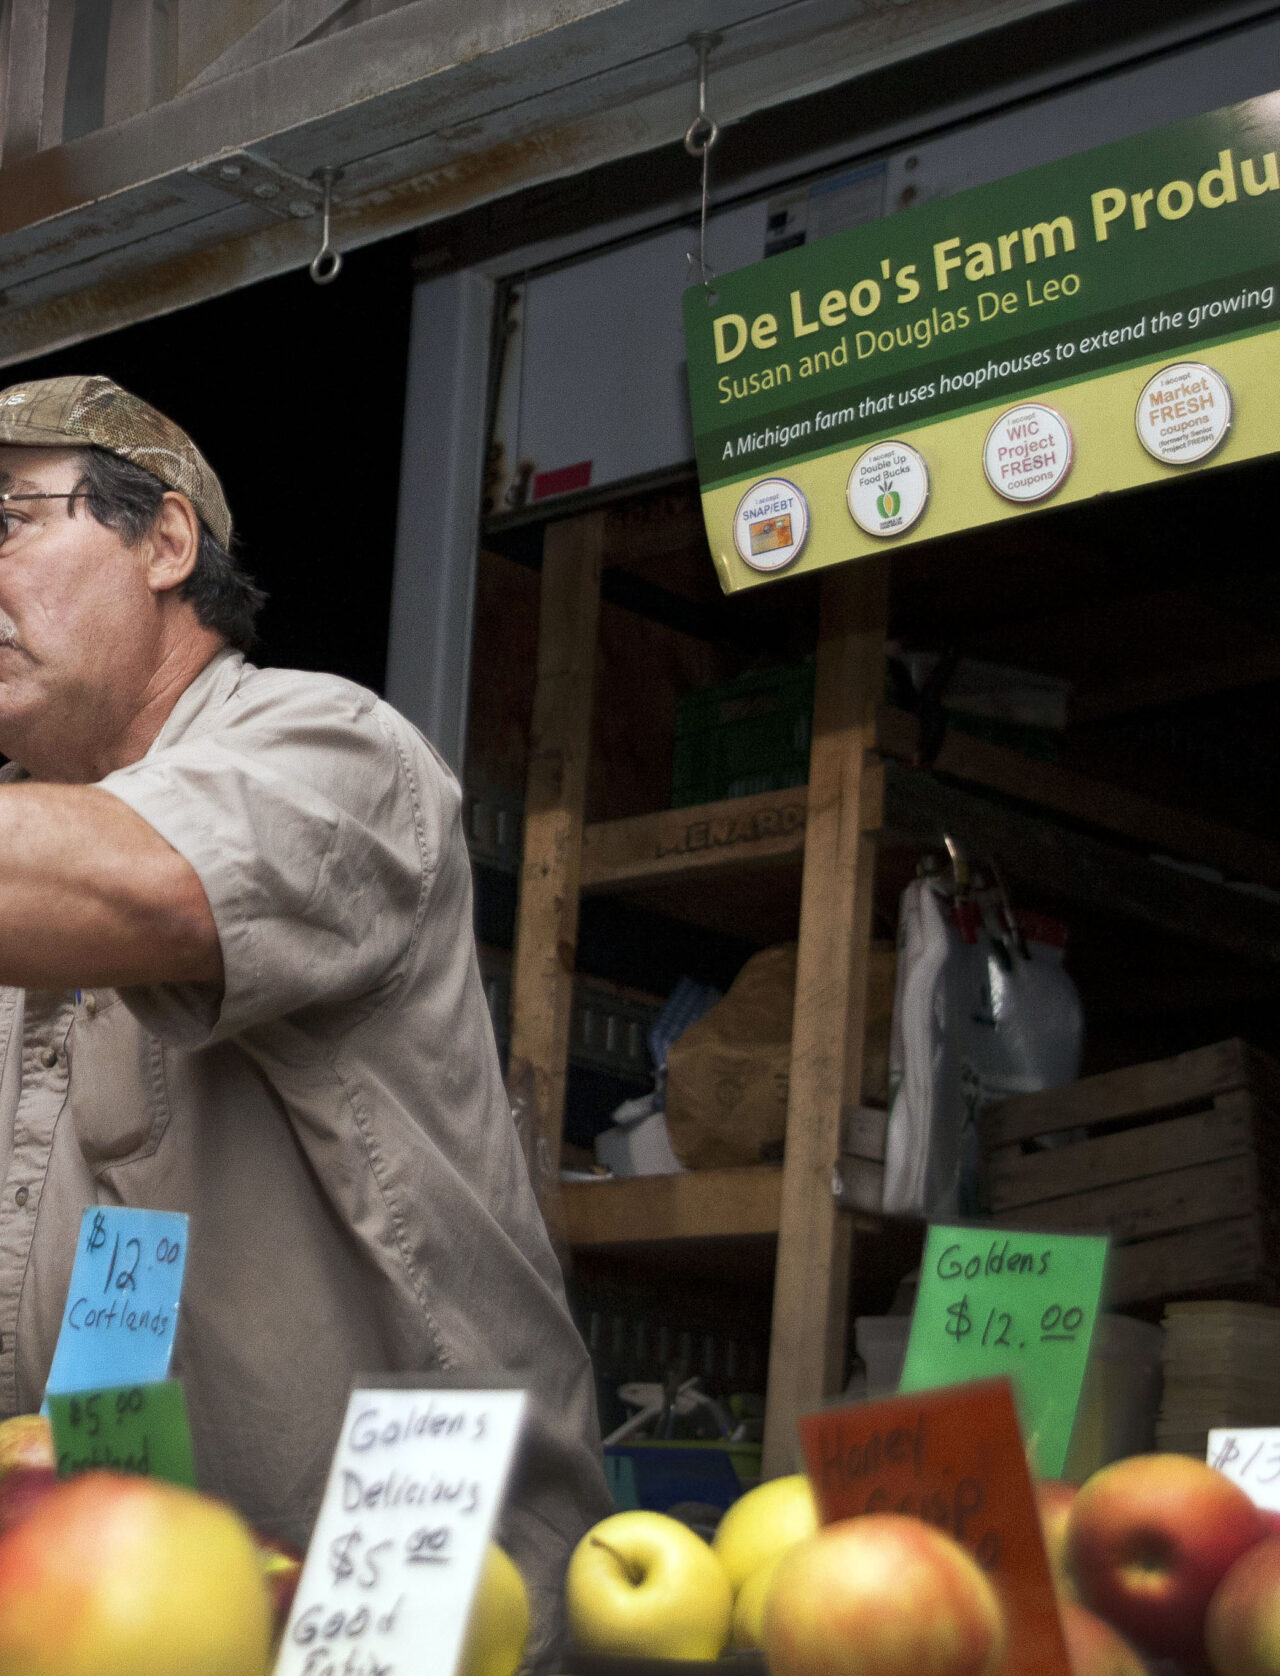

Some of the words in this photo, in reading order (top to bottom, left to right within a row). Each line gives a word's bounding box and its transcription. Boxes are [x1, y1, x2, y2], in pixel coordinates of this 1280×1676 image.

[713, 313, 778, 364] De
[790, 258, 920, 338] Leo's
[933, 215, 1076, 291] Farm
[1091, 149, 1280, 242] Produ
[718, 362, 791, 404] Susan
[799, 337, 849, 377] and
[856, 306, 969, 359] Douglas
[977, 291, 1018, 322] De
[1026, 274, 1081, 307] Leo
[722, 441, 734, 461] A
[737, 420, 812, 456] Michigan
[814, 407, 855, 432] farm
[858, 393, 894, 418] that
[898, 382, 935, 406] uses
[939, 348, 1051, 395] hoophouses
[1056, 342, 1075, 361] to
[1079, 316, 1146, 352] extend
[1151, 311, 1183, 333] the
[1188, 286, 1274, 329] growing
[1149, 377, 1209, 407] Market
[1149, 391, 1214, 426] FRESH
[1007, 421, 1040, 441] WIC
[1160, 415, 1209, 437] coupons
[998, 433, 1055, 461] Project
[859, 473, 881, 487] Food
[882, 465, 911, 480] Bucks
[860, 460, 891, 476] Double
[893, 455, 907, 465] Up
[1001, 451, 1056, 479] FRESH
[1008, 471, 1054, 490] coupons
[742, 497, 794, 521] SNAP/EBT
[937, 1240, 1050, 1280] Goldens
[68, 1297, 169, 1336] Cortlands
[349, 1403, 489, 1452] Goldens
[343, 1468, 479, 1515] Delicious
[293, 1593, 405, 1644] Good
